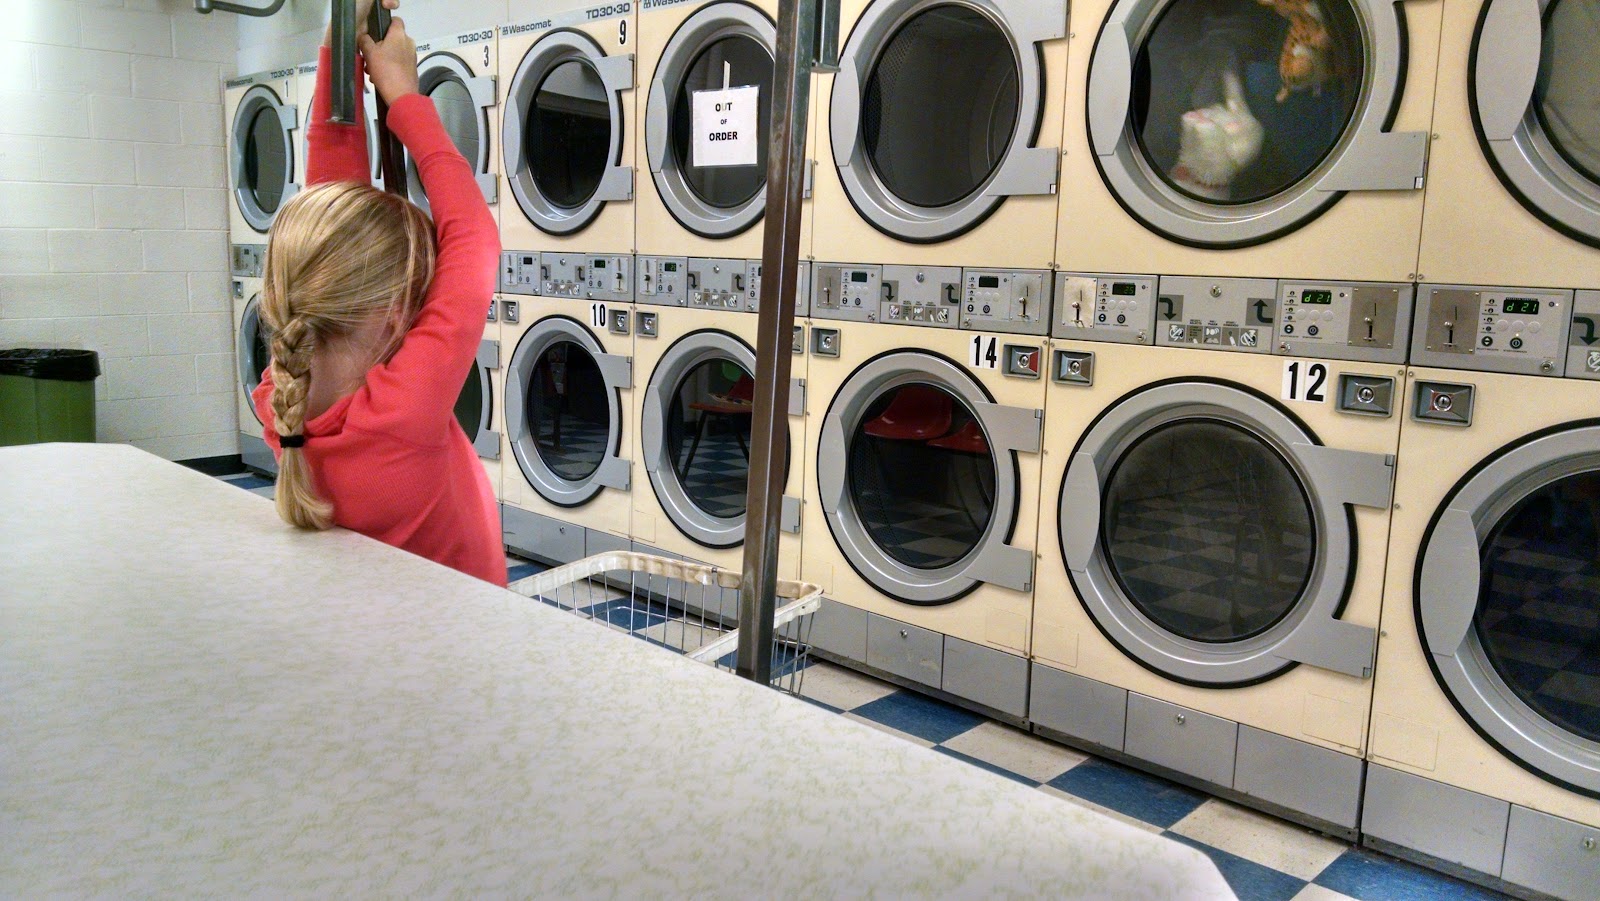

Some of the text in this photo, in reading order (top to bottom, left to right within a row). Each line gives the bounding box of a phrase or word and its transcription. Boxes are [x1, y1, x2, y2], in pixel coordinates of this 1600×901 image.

[508, 18, 552, 34] Wascomat
[619, 19, 627, 45] 9
[483, 45, 490, 67] 3
[715, 102, 733, 112] OUT
[708, 131, 738, 142] ORDER
[1316, 293, 1331, 303] 21
[1506, 302, 1537, 312] d 21
[592, 303, 606, 327] 10
[973, 335, 997, 369] 14
[1287, 361, 1328, 402] 12
